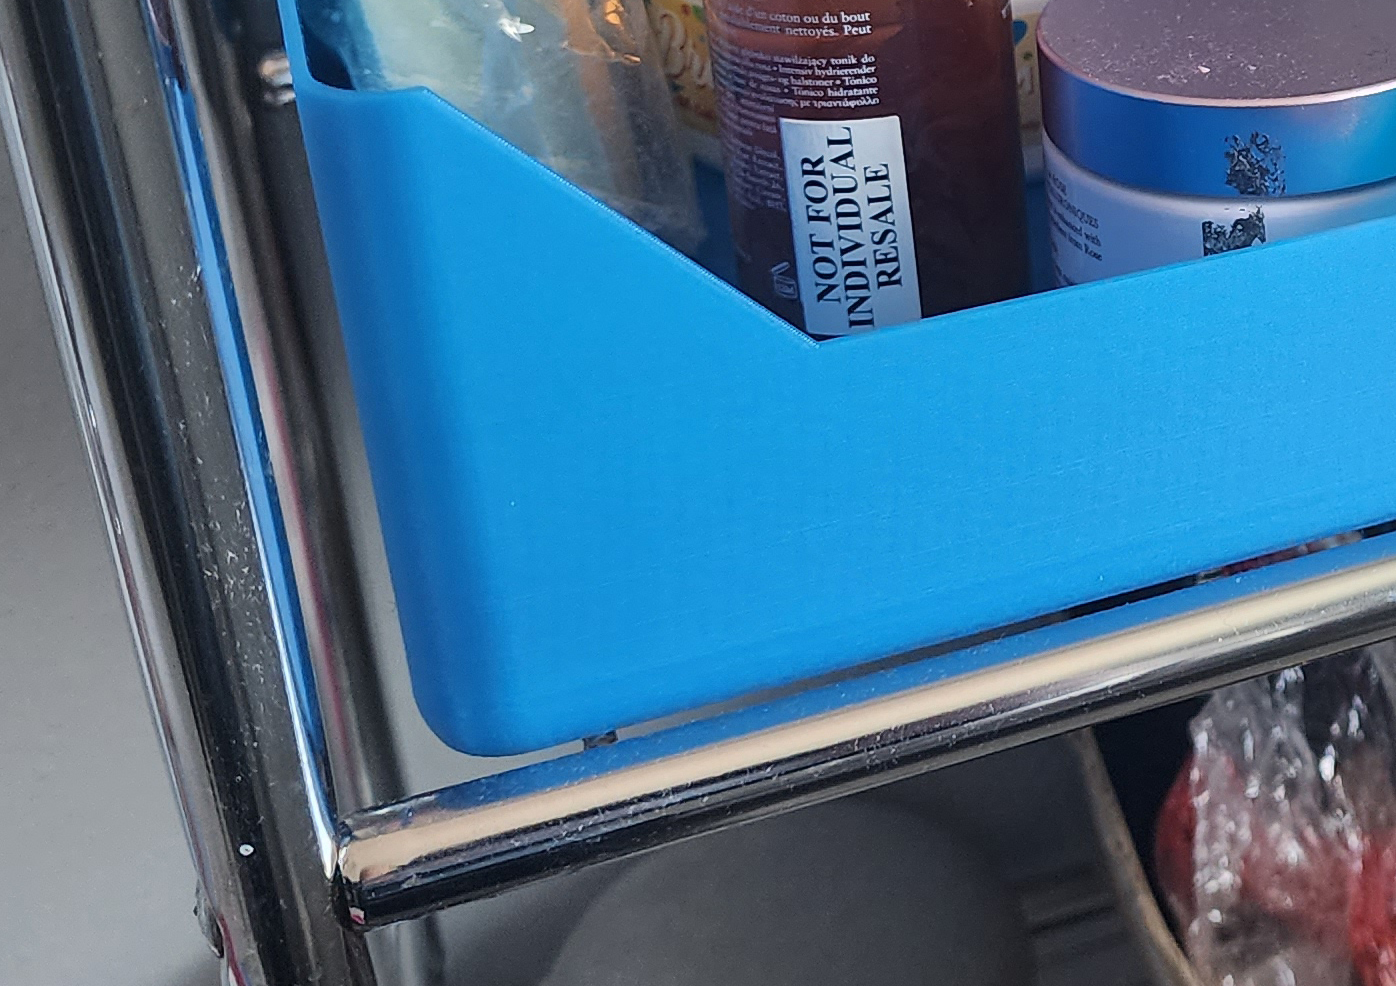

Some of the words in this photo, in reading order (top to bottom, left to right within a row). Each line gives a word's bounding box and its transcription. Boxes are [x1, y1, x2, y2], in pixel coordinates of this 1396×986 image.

[768, 13, 801, 24] coton
[803, 14, 820, 24] ou
[821, 11, 838, 24] du
[840, 11, 871, 24] bout
[784, 23, 840, 39] nettoyés.
[843, 23, 873, 37] Peut
[830, 54, 858, 66] tonik
[861, 53, 876, 65] do
[814, 64, 877, 78] hydrierender
[842, 75, 878, 86] Tónico
[827, 86, 879, 97] hidratante
[800, 154, 833, 226] FOR
[826, 125, 876, 329] INDIVIDUAL
[863, 162, 904, 291] RESALE
[809, 233, 843, 304] NOT
